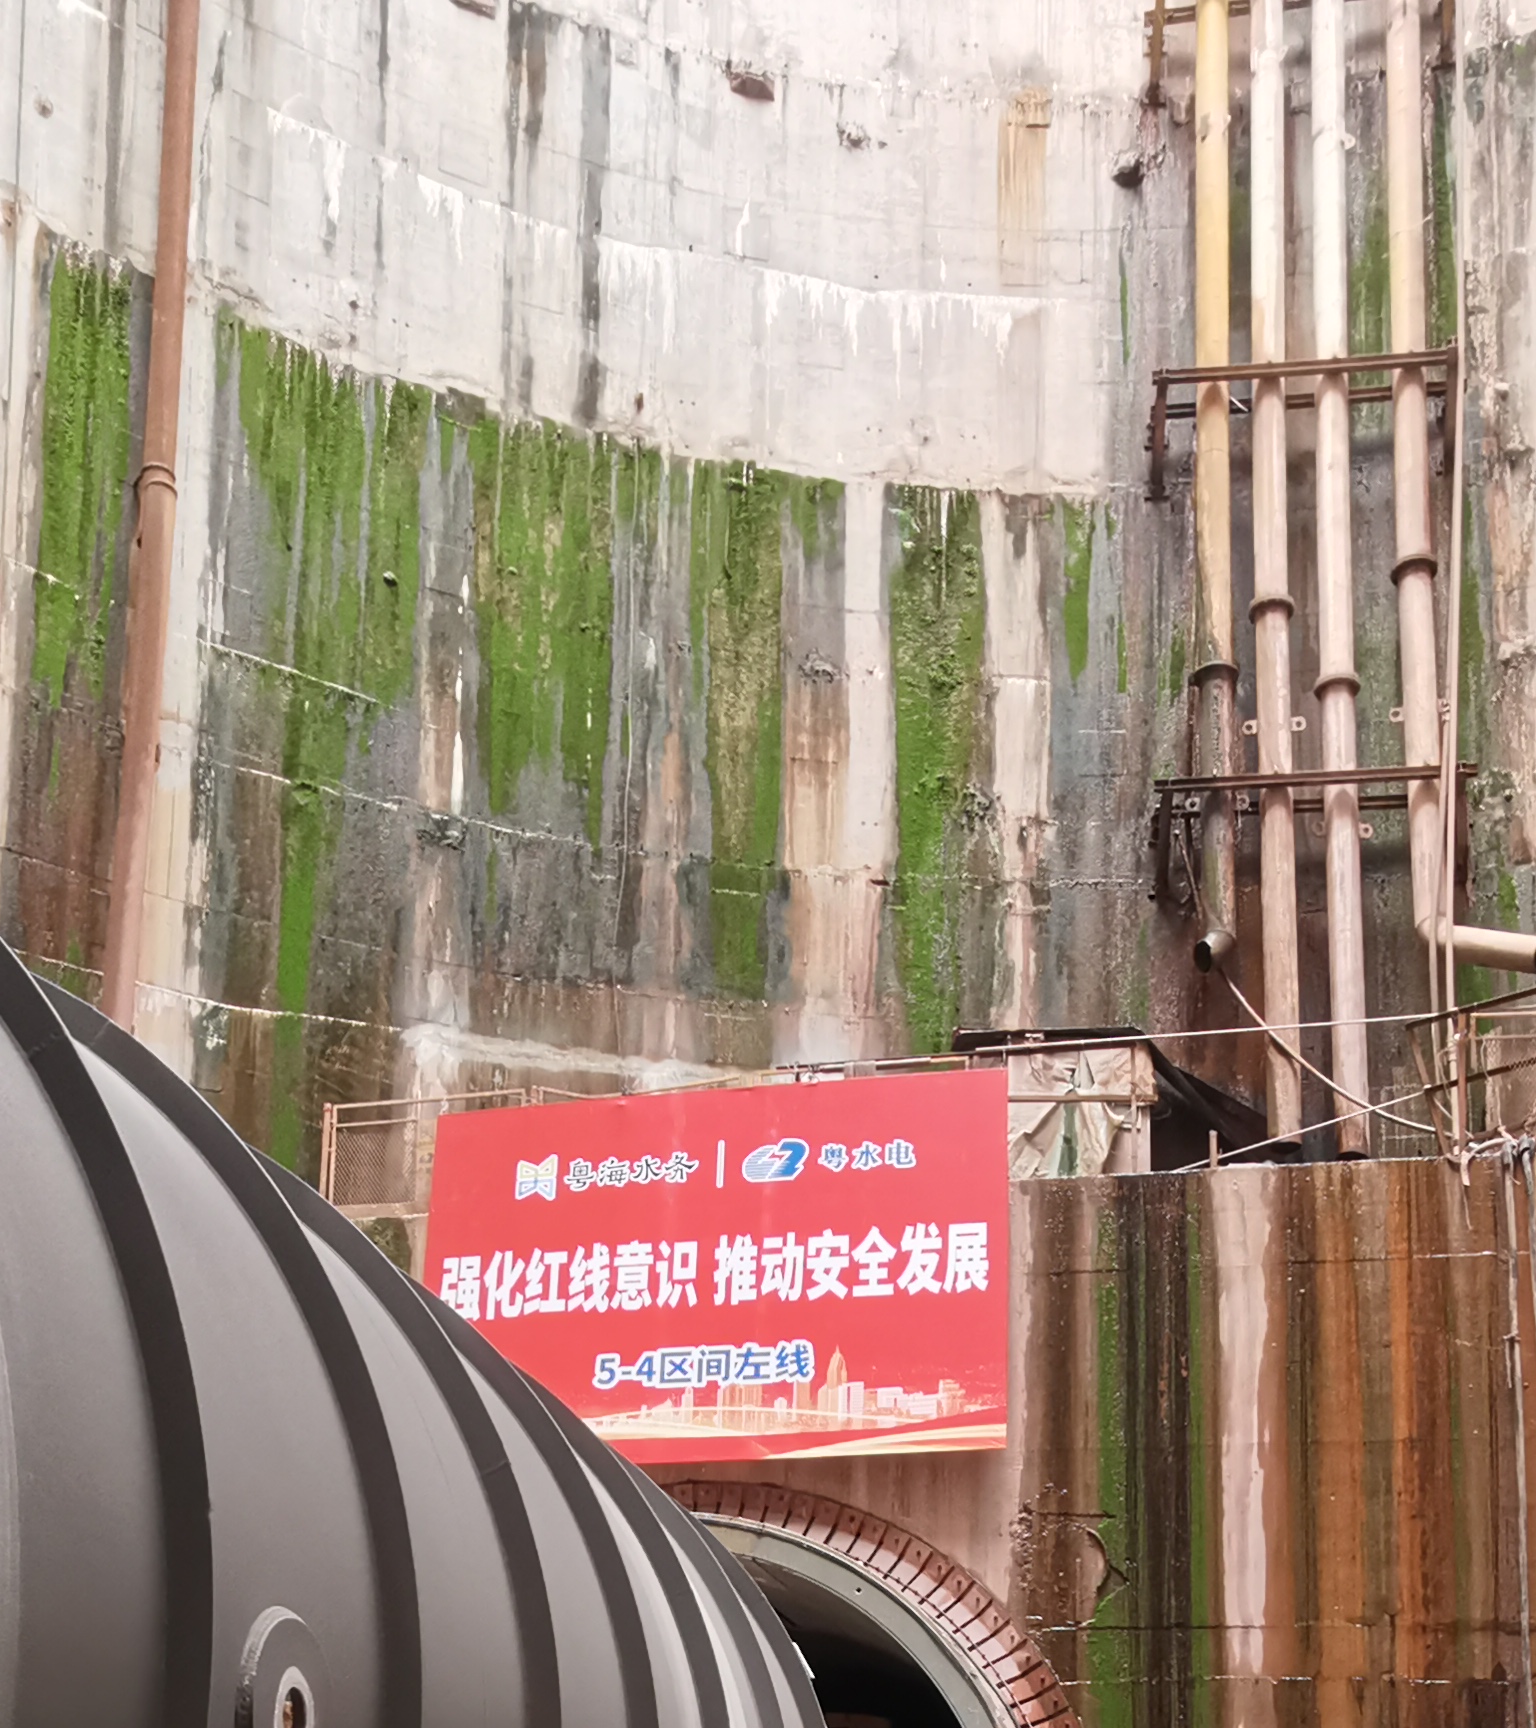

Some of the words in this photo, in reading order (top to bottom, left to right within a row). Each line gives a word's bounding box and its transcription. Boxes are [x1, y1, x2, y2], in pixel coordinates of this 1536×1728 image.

[563, 1152, 700, 1192] 粤海水务
[817, 1138, 917, 1171] 粤水电
[440, 1239, 699, 1321] 强化红线意识
[713, 1221, 990, 1305] 推动安全发展
[592, 1339, 815, 1390] 5-4区间左线
